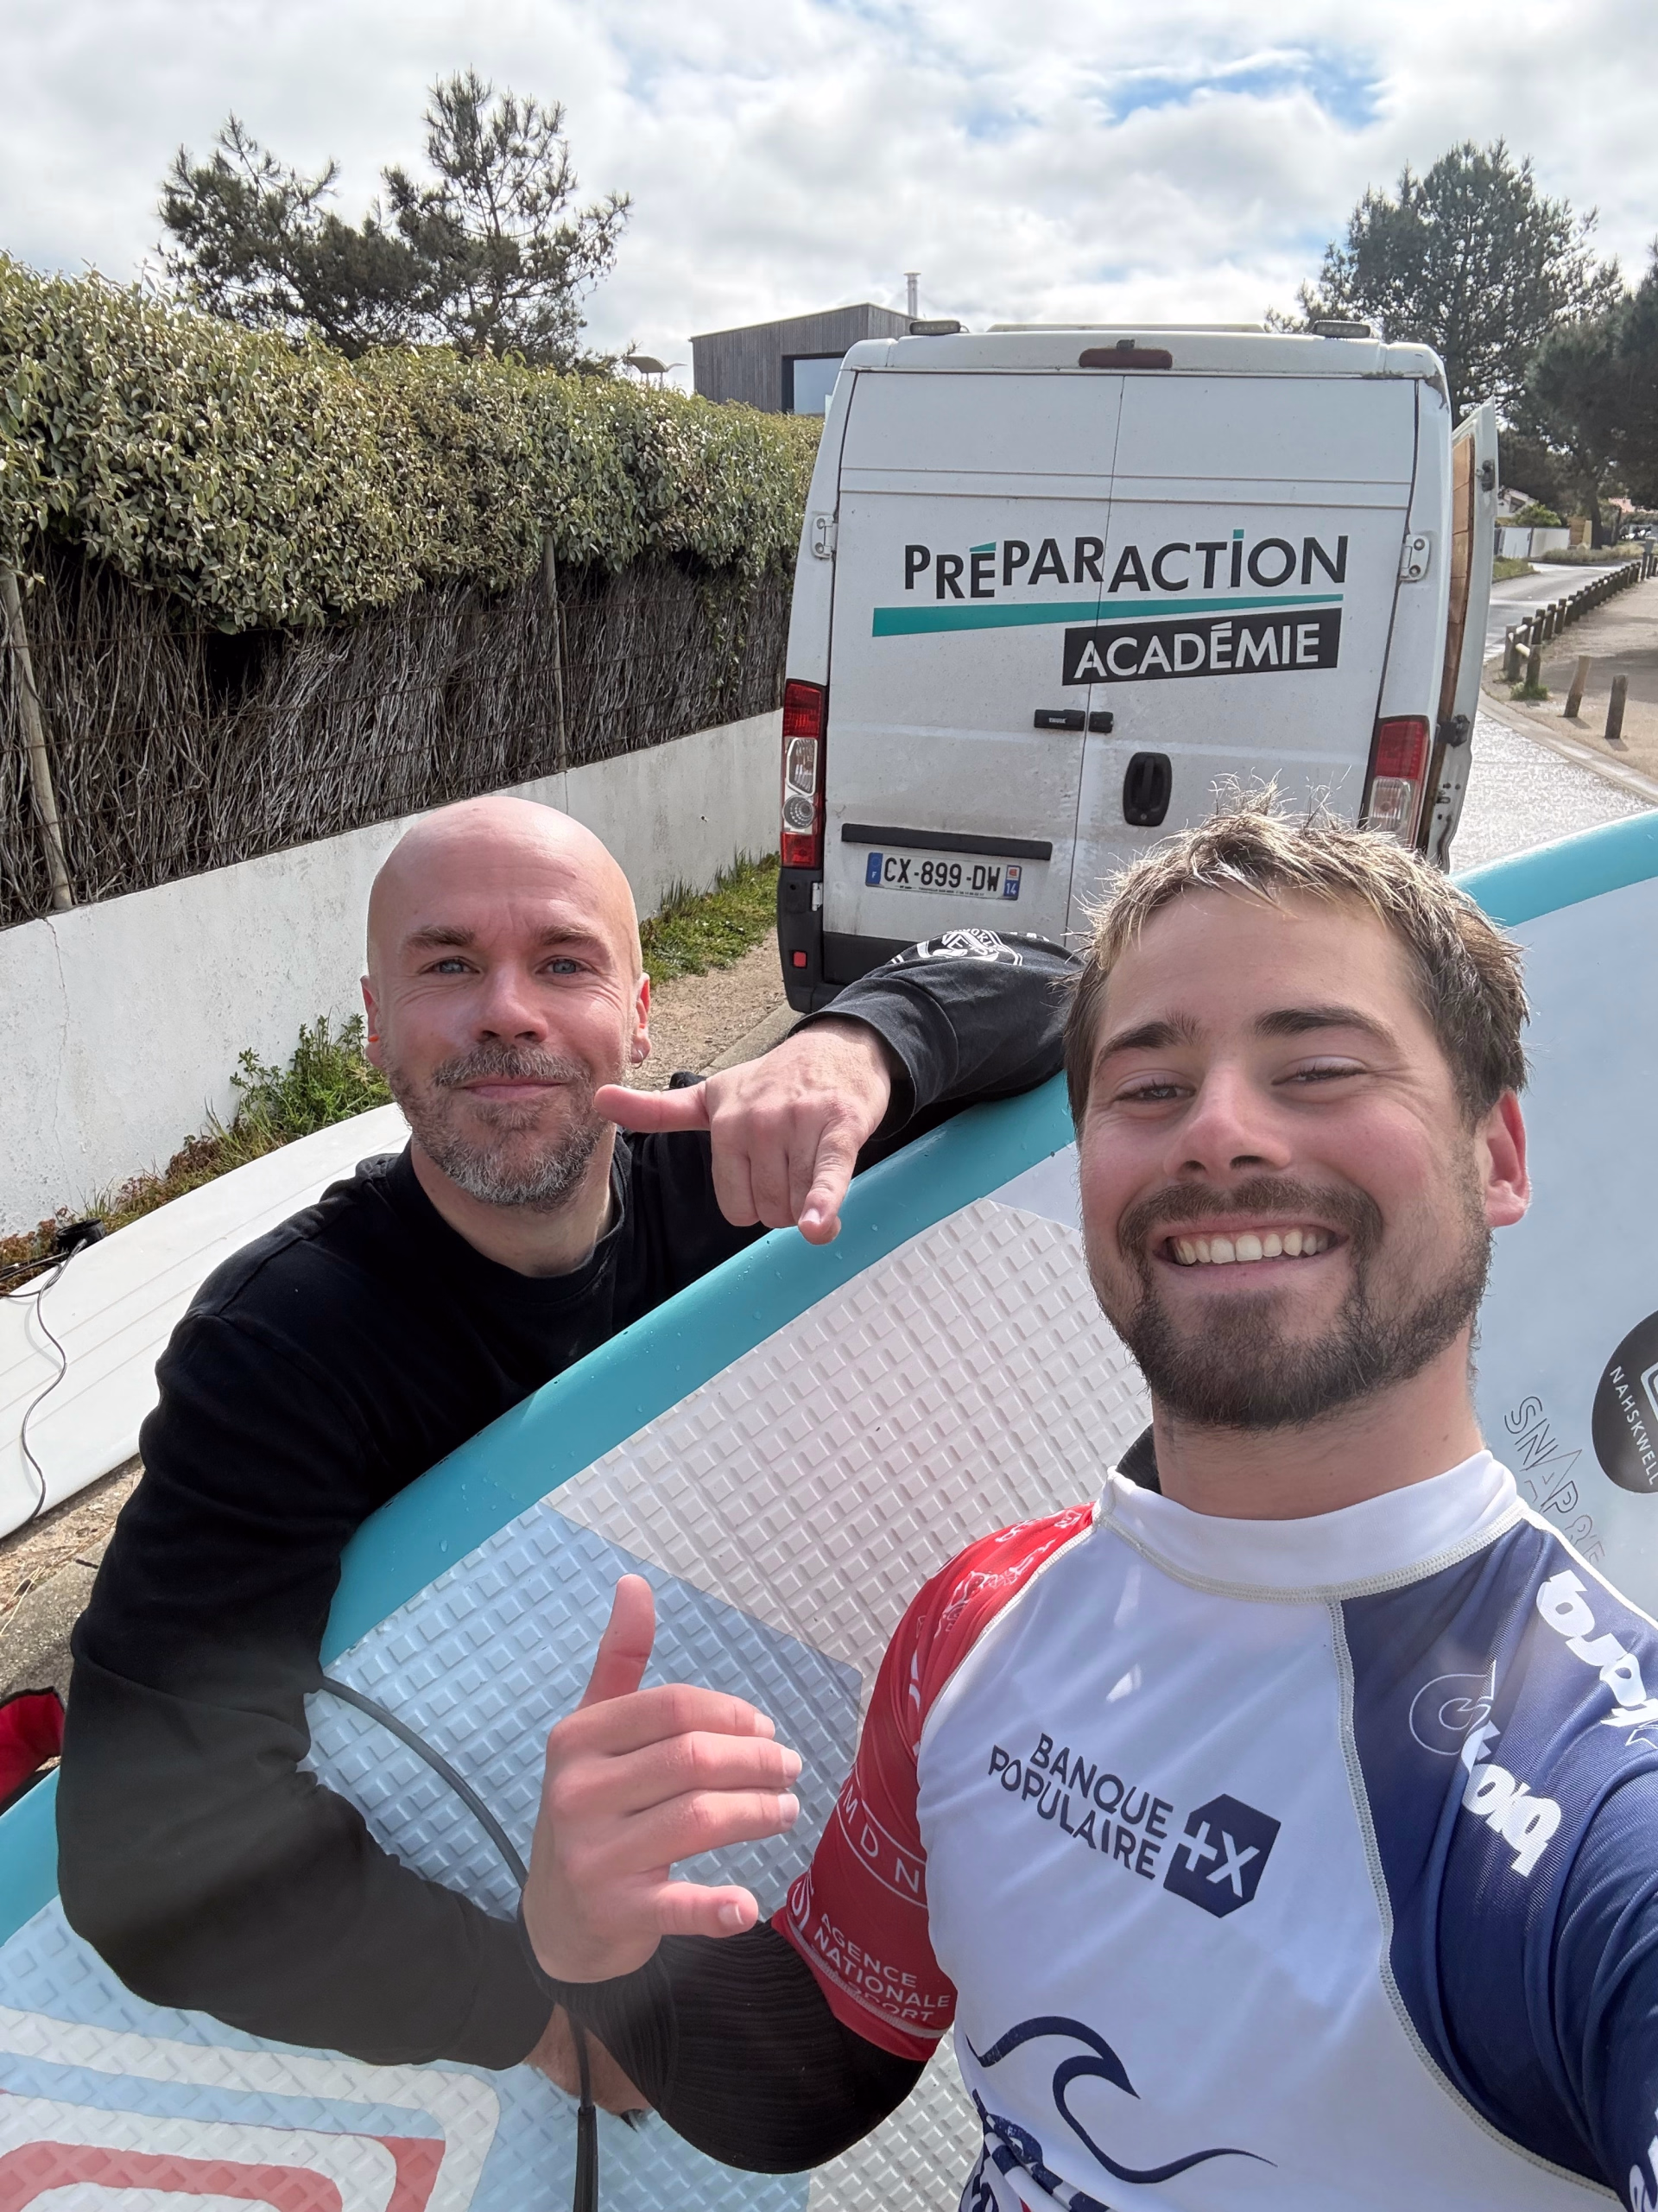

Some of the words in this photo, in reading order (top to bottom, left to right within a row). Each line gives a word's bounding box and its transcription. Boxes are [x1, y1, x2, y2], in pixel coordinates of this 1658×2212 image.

[1074, 621, 1319, 678] ACADÉMIE
[1005, 882, 1017, 895] 14
[1609, 1366, 1658, 1486] NAHSKWELL
[988, 1745, 1161, 1880] POPULAIRE
[1030, 1733, 1174, 1840] BANQUE
[814, 1926, 951, 2009] NATIONALE
[821, 1912, 917, 1987] AGENCE
